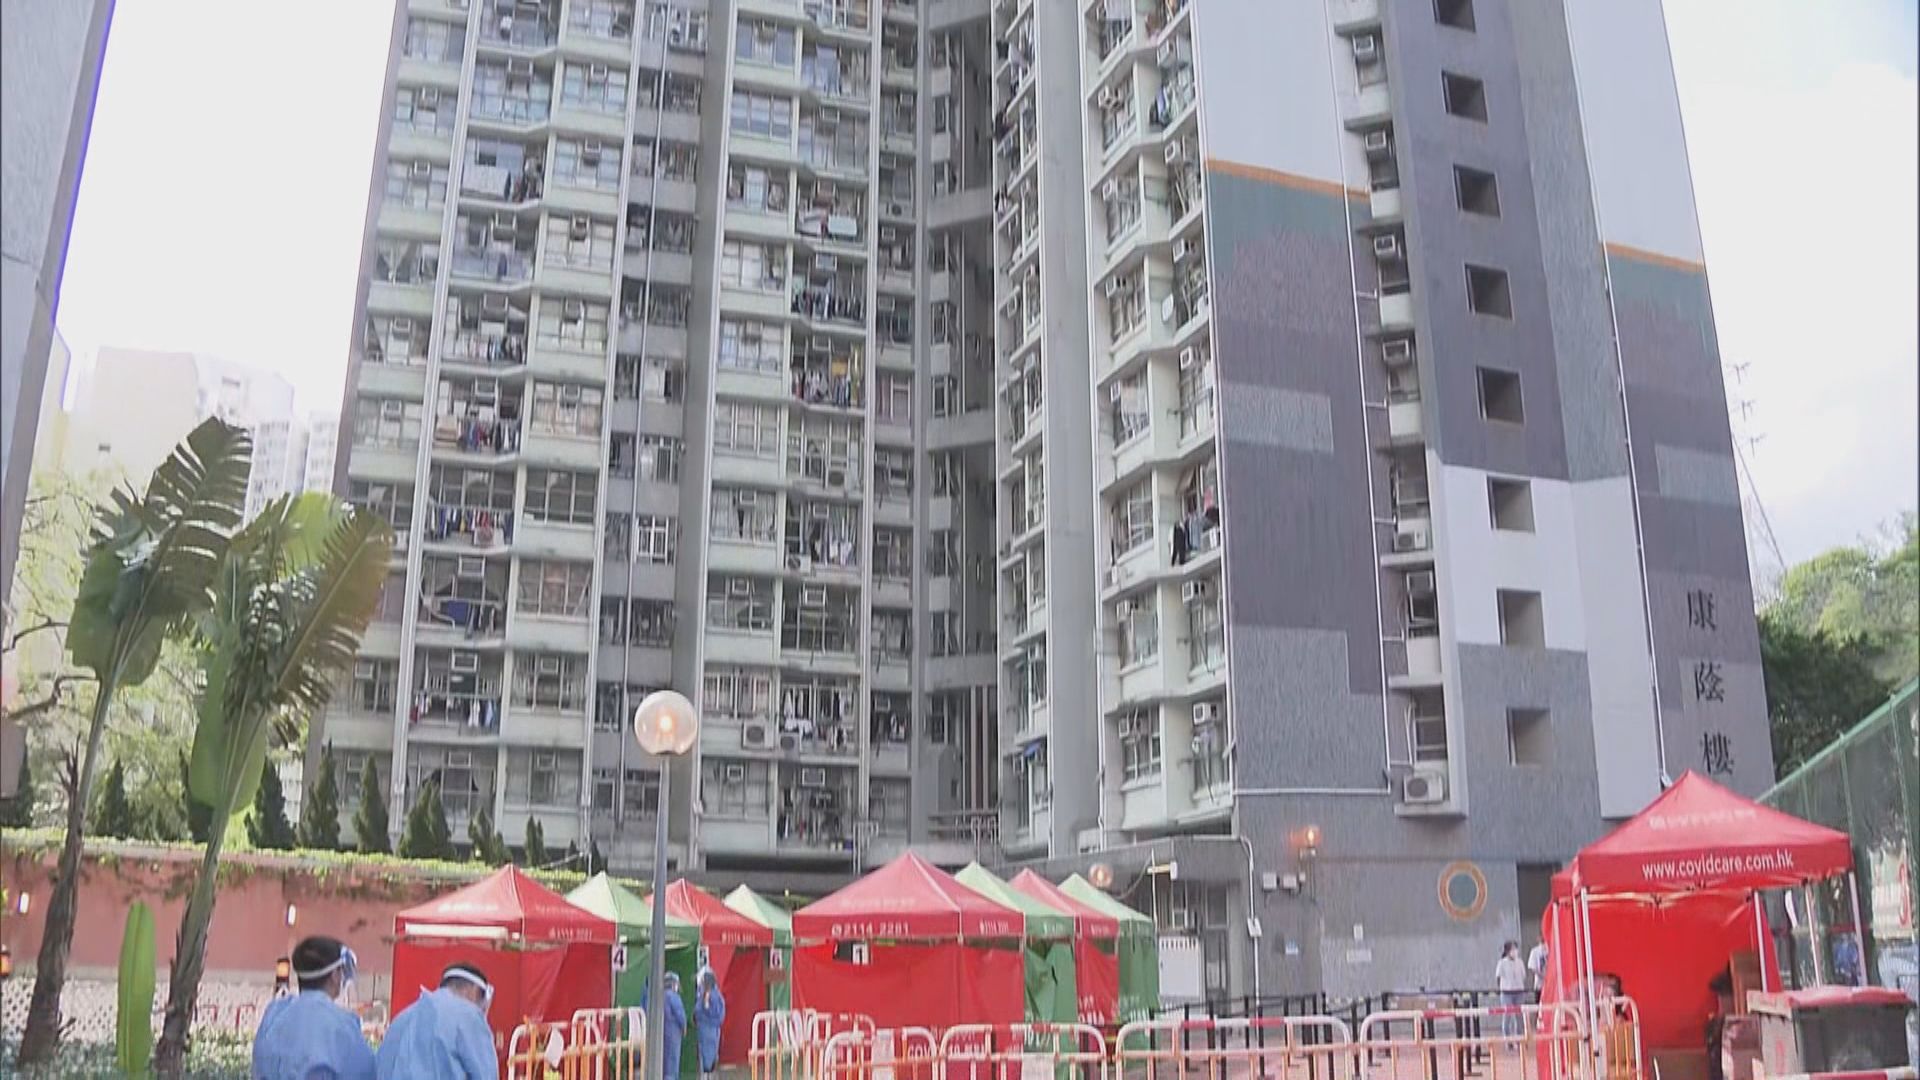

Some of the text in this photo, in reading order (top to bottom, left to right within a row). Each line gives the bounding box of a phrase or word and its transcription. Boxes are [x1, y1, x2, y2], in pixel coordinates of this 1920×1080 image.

[1642, 848, 1794, 880] www.covidcare.com.hk
[613, 947, 624, 968] 4
[771, 950, 780, 967] 6
